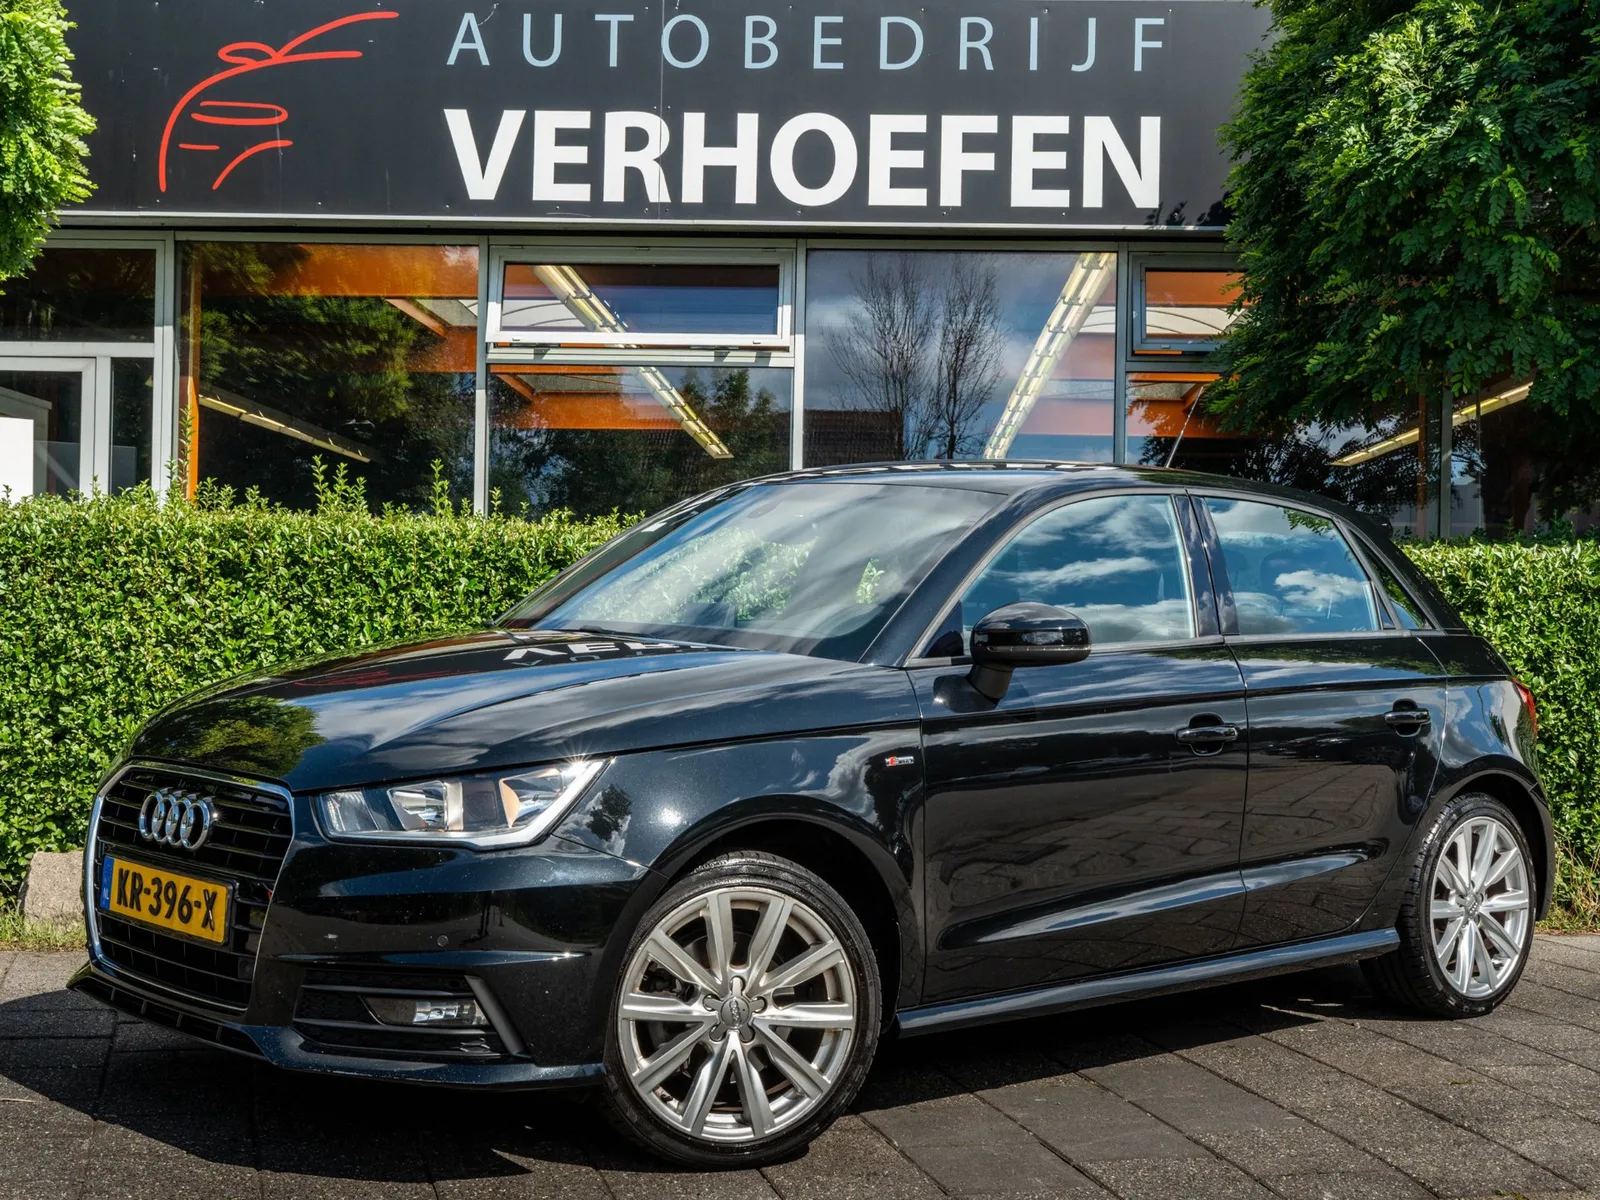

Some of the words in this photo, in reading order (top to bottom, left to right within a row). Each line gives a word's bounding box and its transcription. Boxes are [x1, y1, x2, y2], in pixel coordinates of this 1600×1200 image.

[446, 13, 1165, 72] AUTOBEDRIJF
[443, 108, 1162, 208] VERHOEFEN
[116, 868, 218, 931] KR-396-X
